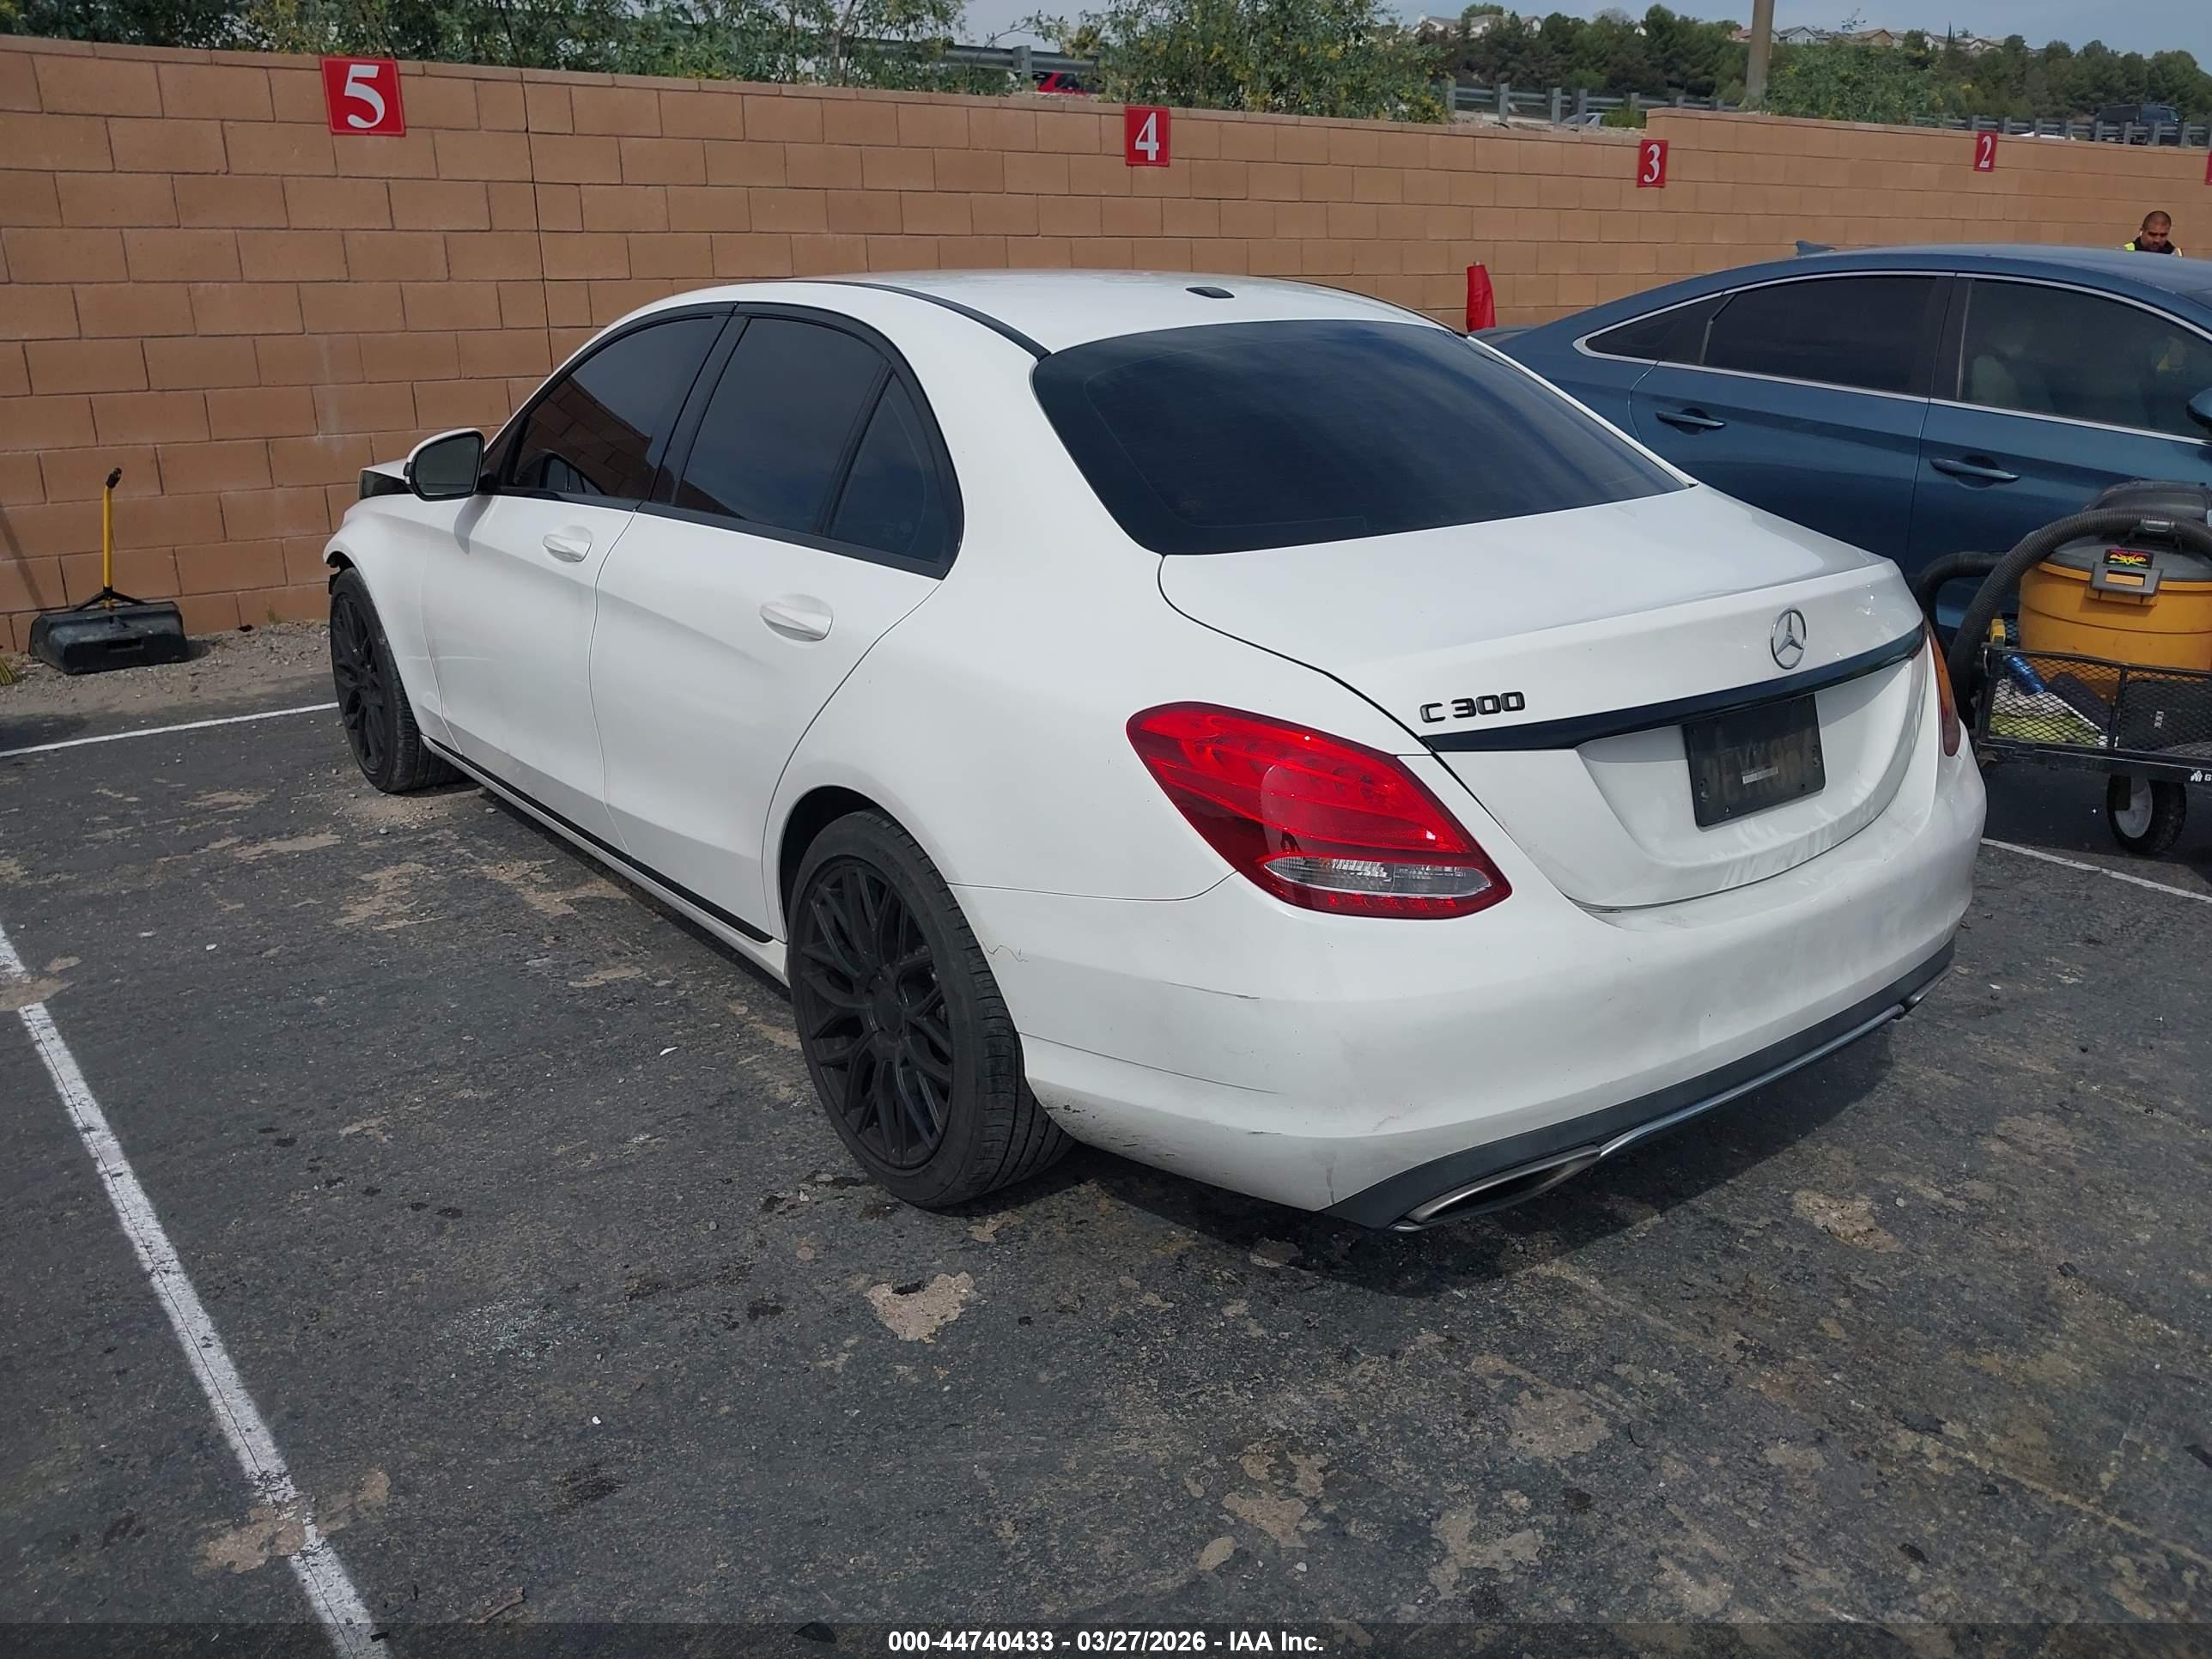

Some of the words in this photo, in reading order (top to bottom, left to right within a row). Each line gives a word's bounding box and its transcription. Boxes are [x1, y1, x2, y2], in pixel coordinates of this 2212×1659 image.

[344, 64, 385, 128] 5
[1135, 112, 1159, 161] 4
[1978, 136, 1992, 168] 2
[1643, 143, 1660, 182] 3
[1419, 702, 1446, 723] C
[1451, 691, 1526, 719] 300
